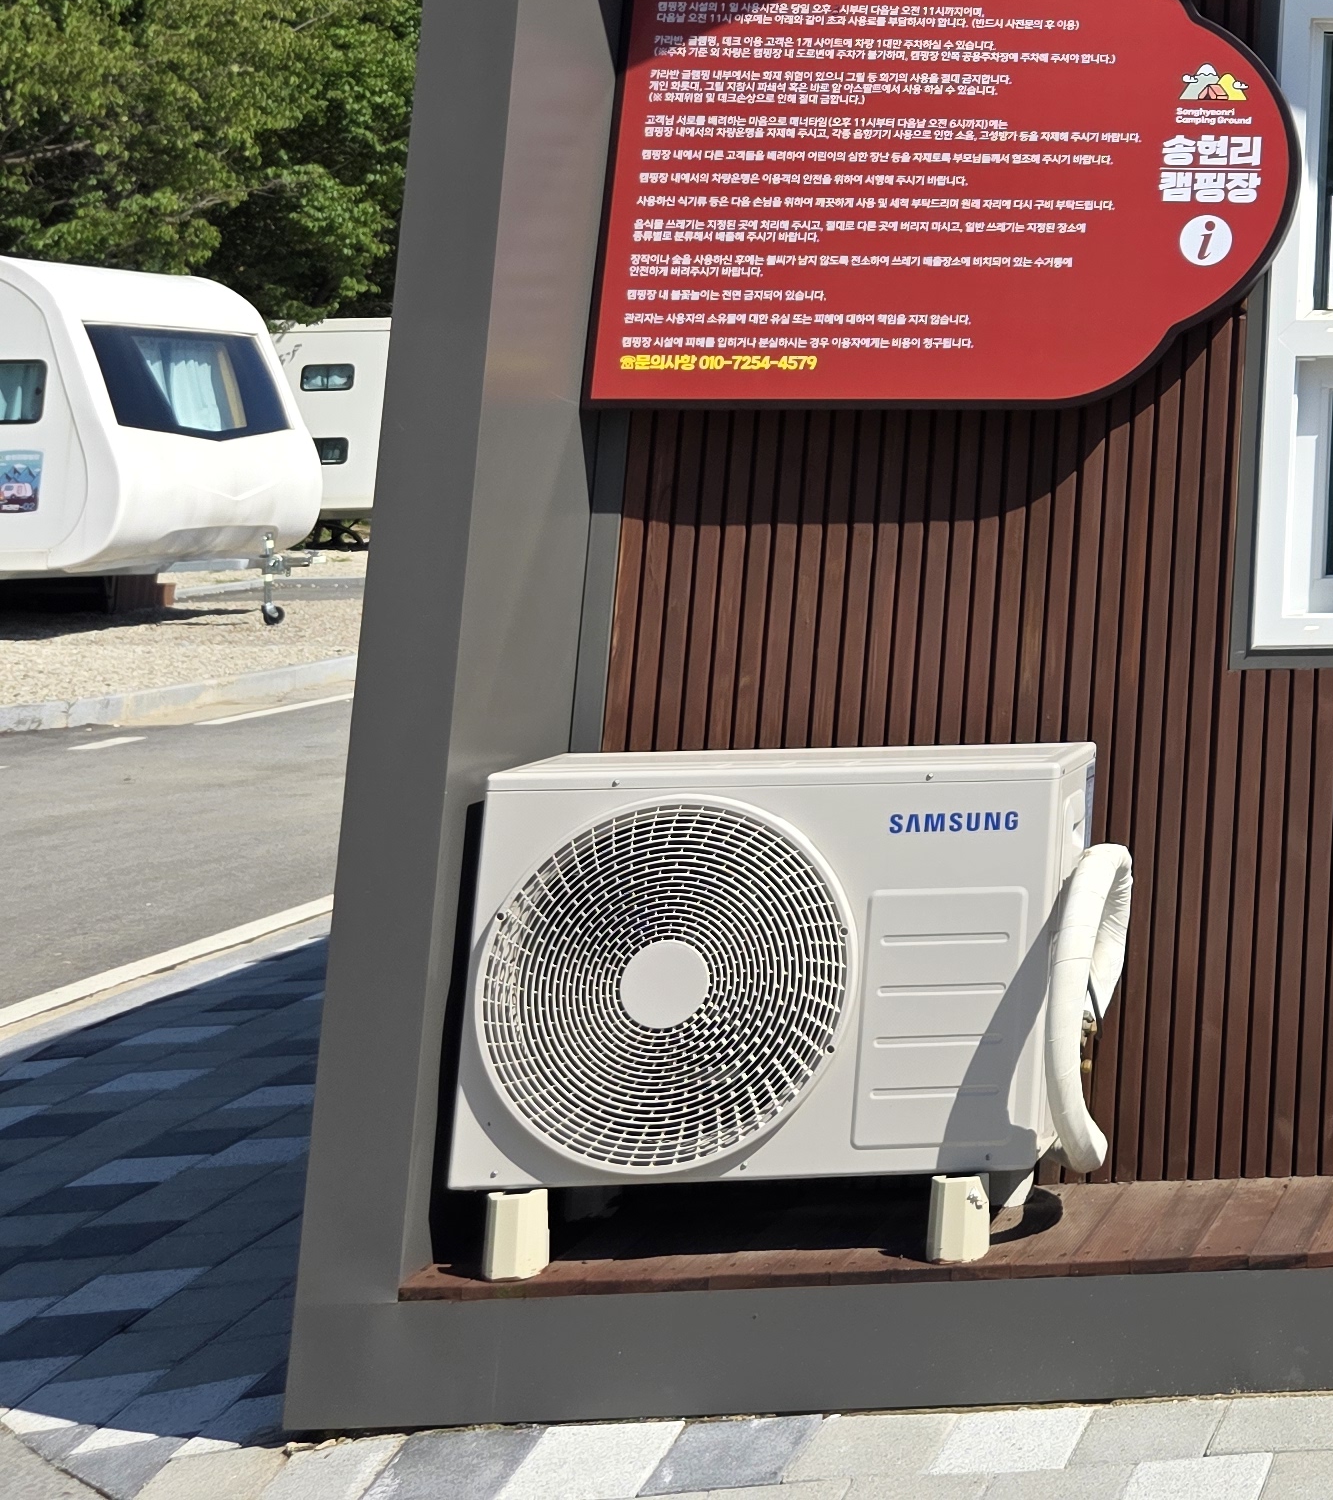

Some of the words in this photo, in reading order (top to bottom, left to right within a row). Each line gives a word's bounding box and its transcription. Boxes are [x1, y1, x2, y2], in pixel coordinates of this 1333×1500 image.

[1176, 107, 1235, 116] Songhyeonri
[1176, 116, 1216, 125] Camping
[1217, 116, 1252, 124] Ground
[1162, 134, 1262, 166] 송현리
[638, 172, 669, 184] 캠핑장
[670, 172, 710, 184] 내에서의
[711, 172, 761, 185] 차량운행은
[761, 173, 801, 185] 이용객의
[802, 173, 833, 185] 안전을
[833, 174, 864, 186] 위하여
[864, 174, 895, 186] 서행해
[895, 175, 926, 186] 주시기
[926, 175, 969, 187] 바랍니다.
[1158, 172, 1262, 203] 캠핑장
[631, 354, 698, 371] 문의사항
[698, 355, 818, 371] 010-7254-4579
[889, 811, 1018, 834] SAMSUNG
